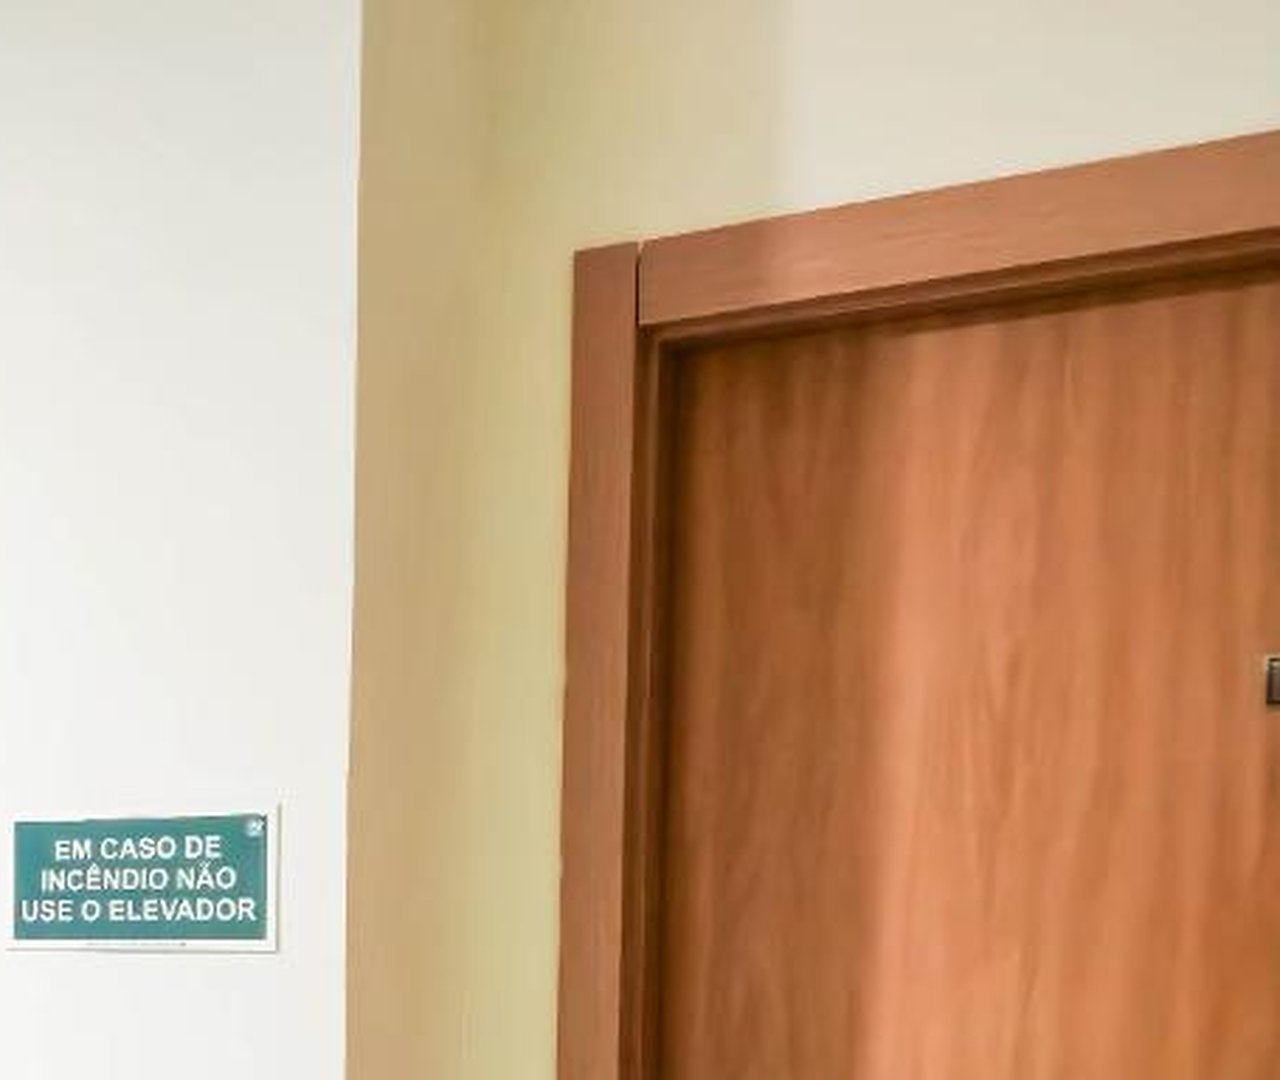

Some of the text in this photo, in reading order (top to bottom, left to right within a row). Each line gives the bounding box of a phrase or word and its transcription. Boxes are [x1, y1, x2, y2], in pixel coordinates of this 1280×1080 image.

[54, 834, 222, 861] EM CASO DE
[41, 861, 237, 891] INCÊNDIO NÃO
[21, 897, 257, 922] USE O ELEVADOR
